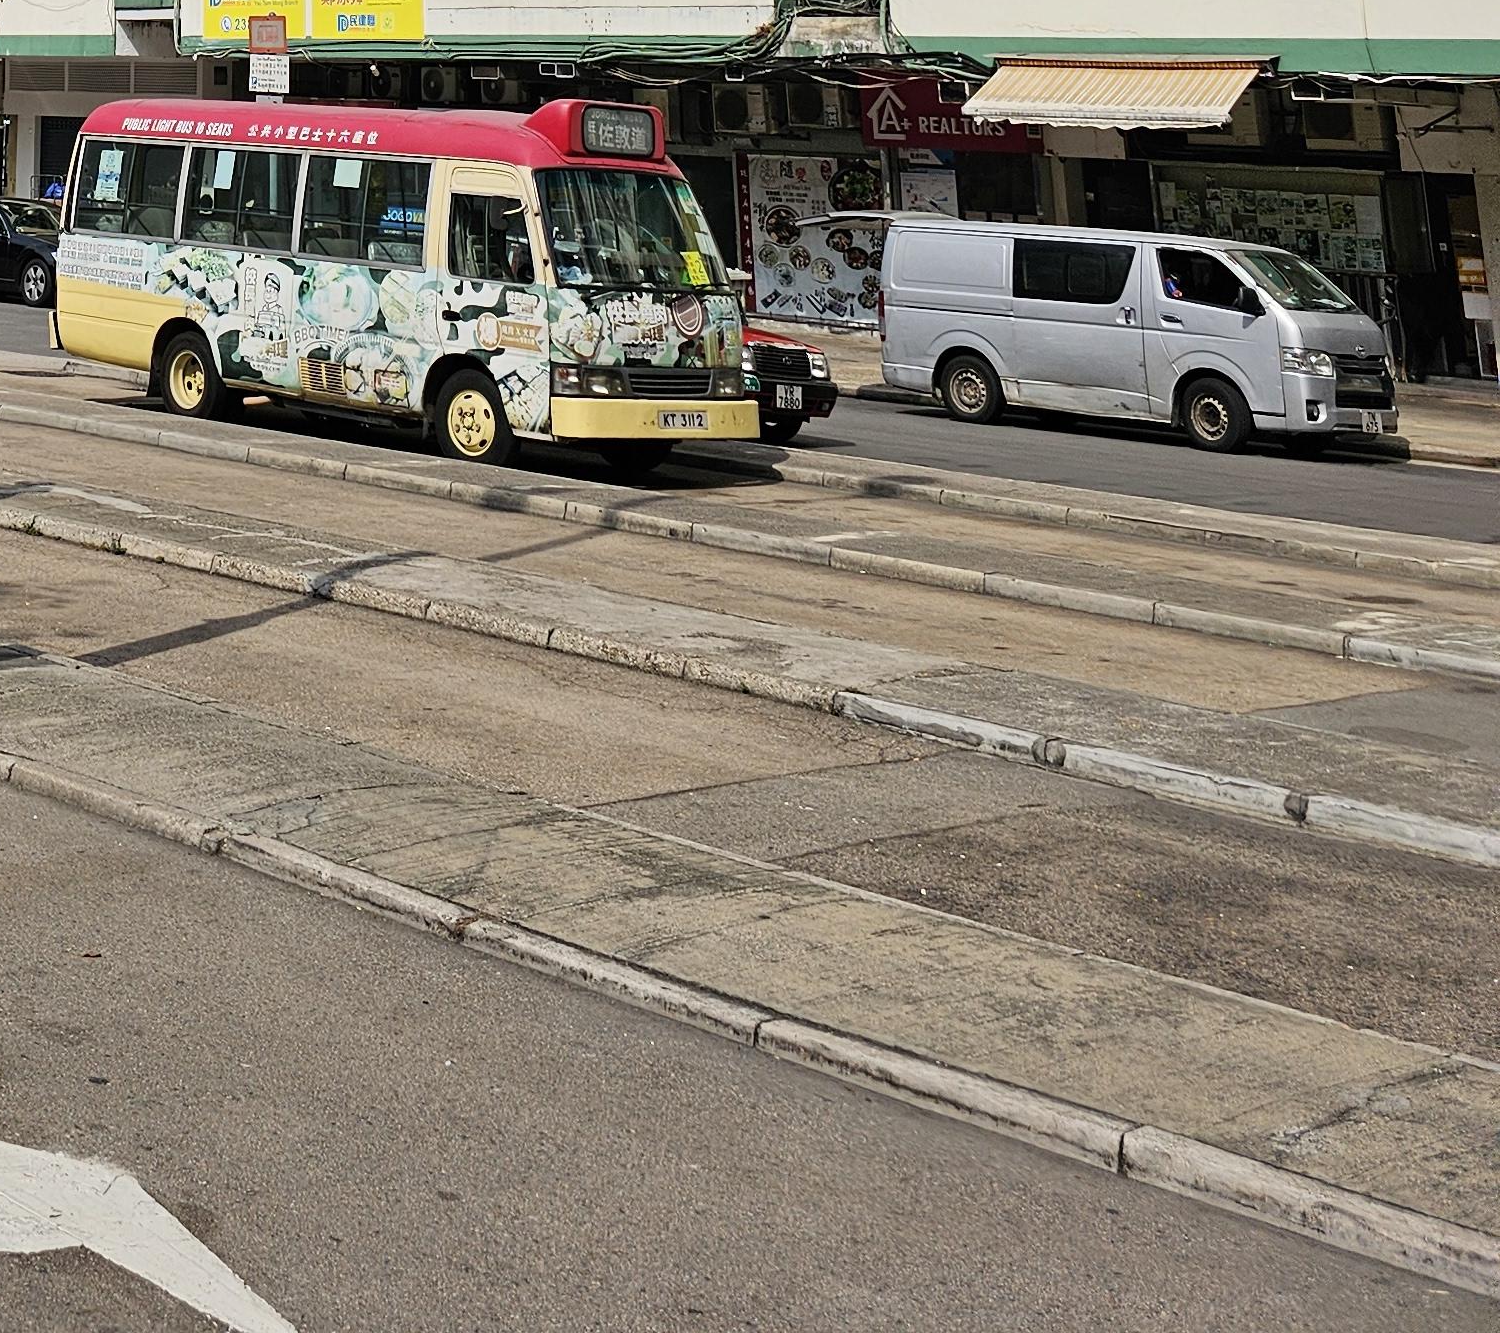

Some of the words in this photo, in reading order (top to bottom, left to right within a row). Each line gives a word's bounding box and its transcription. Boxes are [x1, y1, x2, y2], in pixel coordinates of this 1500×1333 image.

[121, 118, 151, 132] PUBLIC
[151, 119, 177, 133] LIGHT
[176, 120, 193, 134] BUS
[194, 121, 204, 135] 16
[206, 122, 233, 137] SEATS
[248, 124, 379, 145] 公共小型巴士十六座位
[599, 123, 647, 151] 佐敦道
[294, 325, 317, 344] BBQ
[663, 413, 677, 427] KT
[680, 413, 704, 427] 3112
